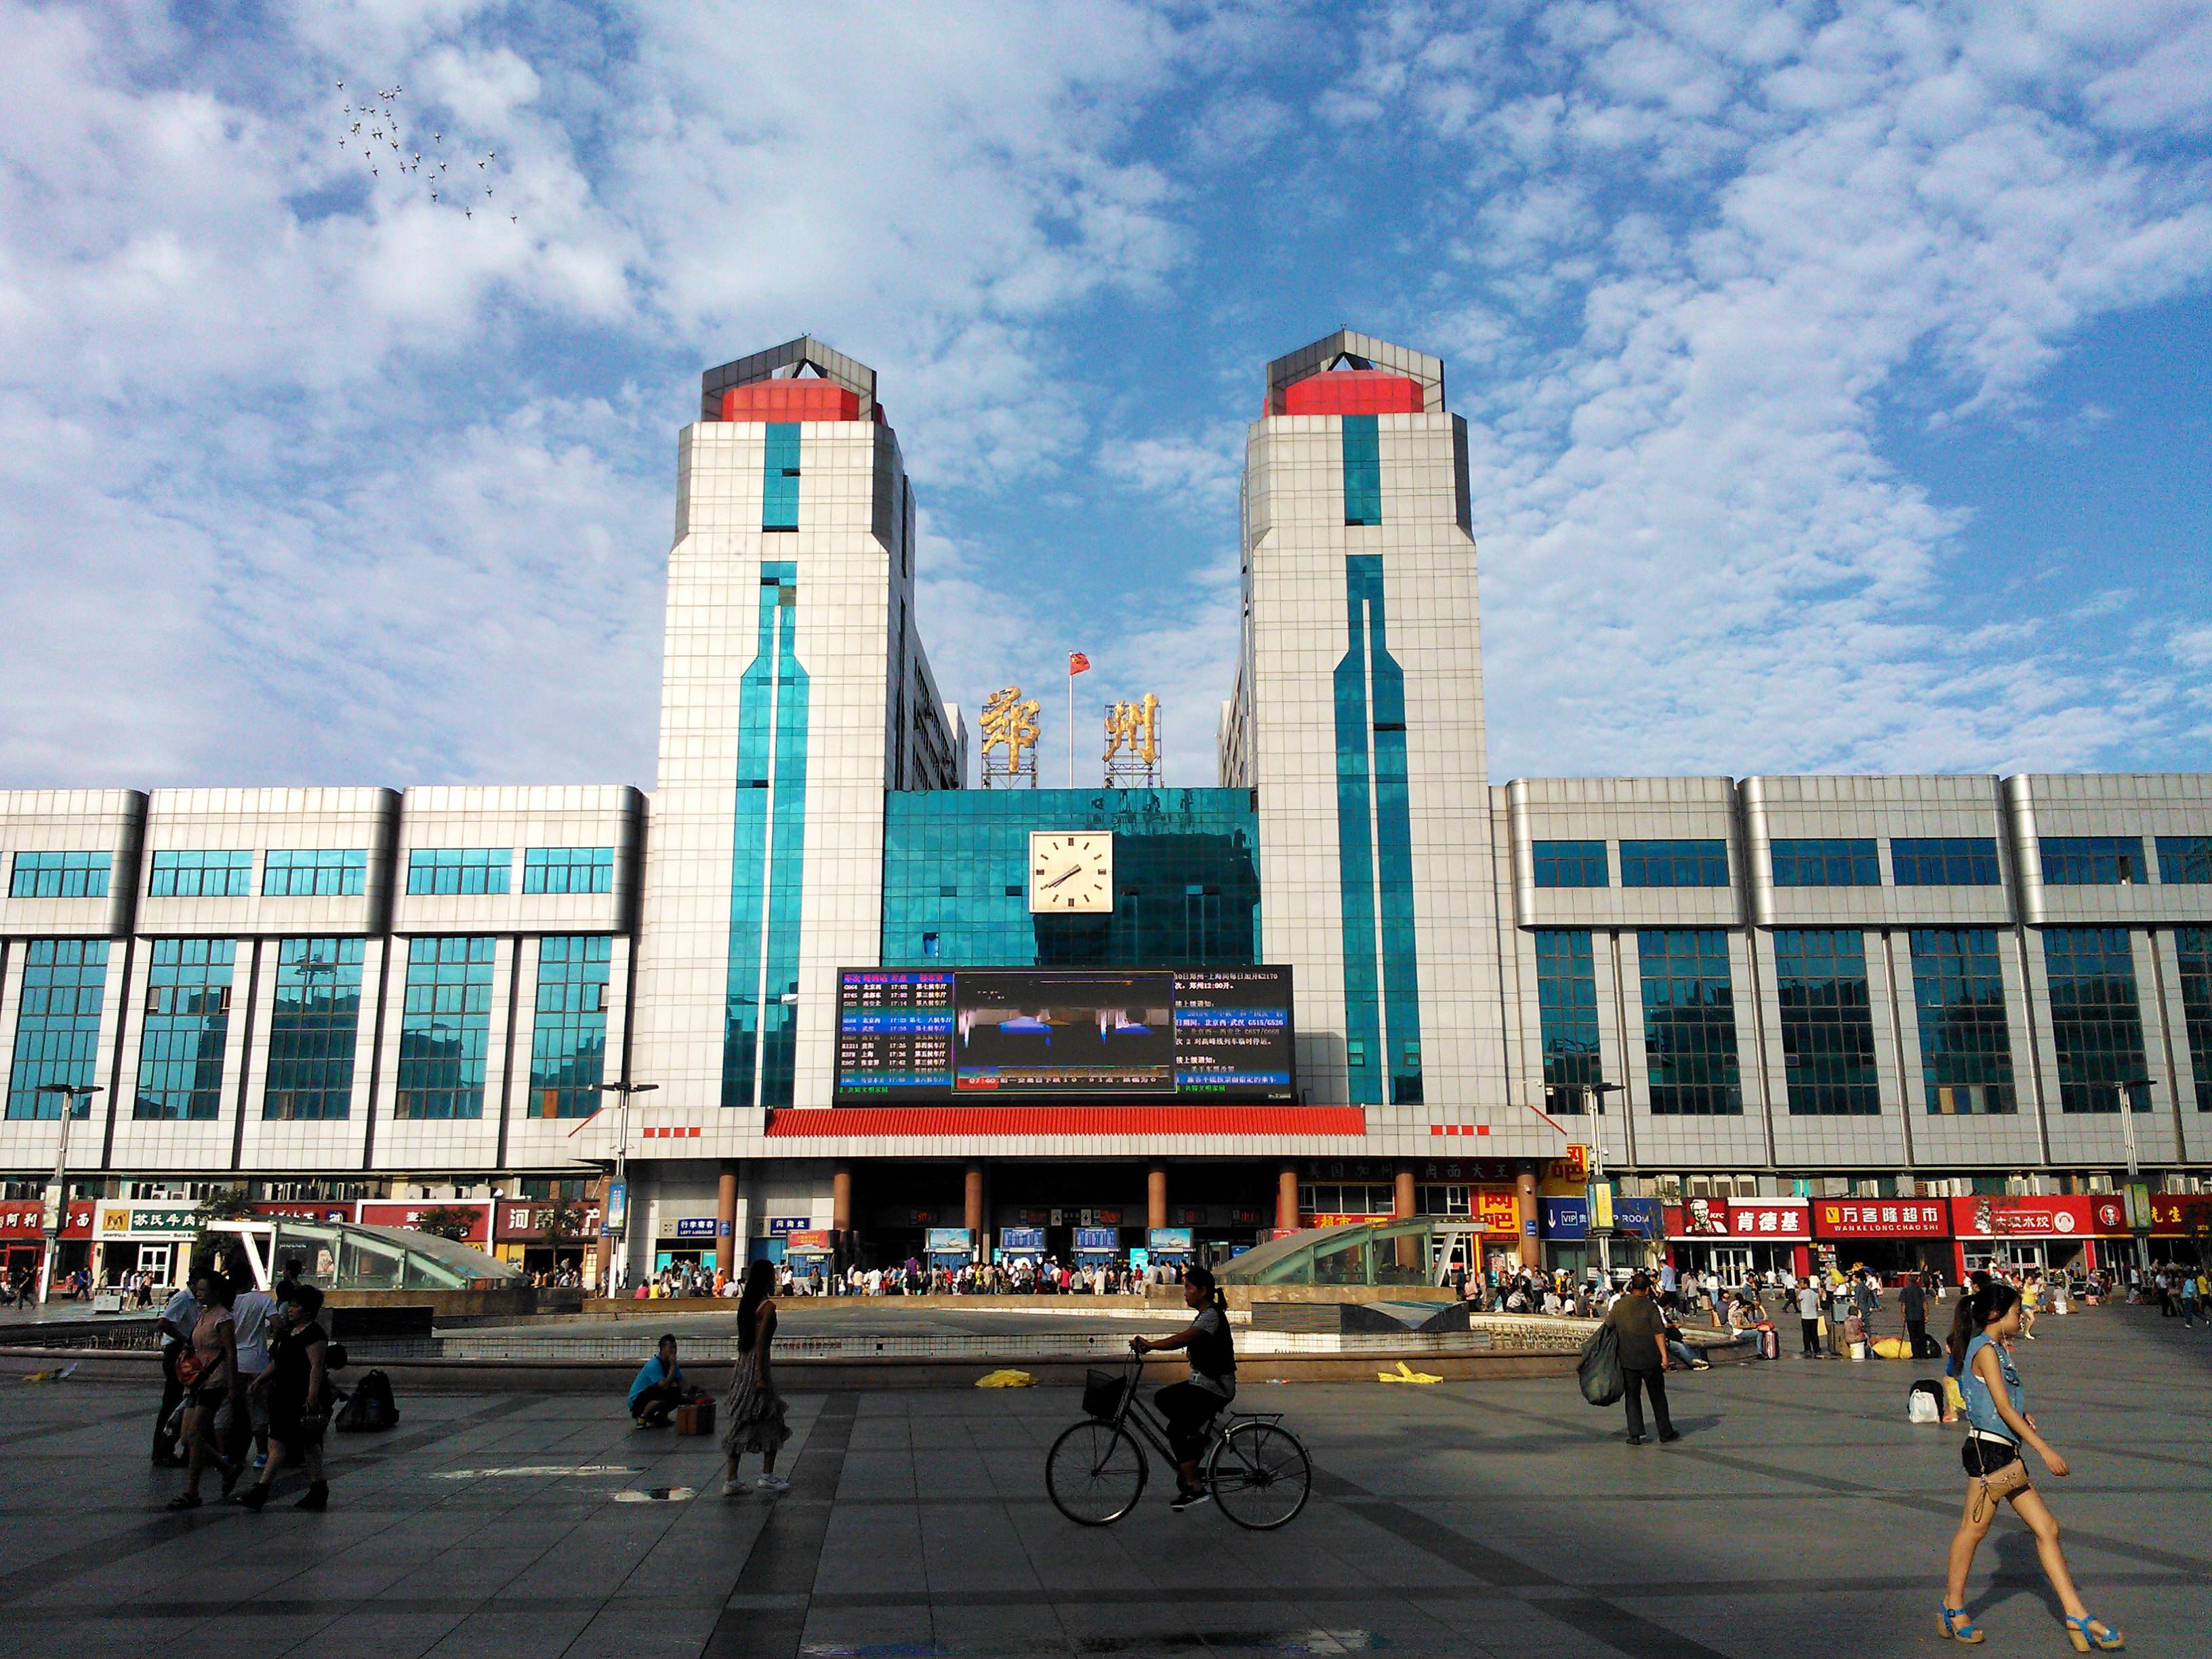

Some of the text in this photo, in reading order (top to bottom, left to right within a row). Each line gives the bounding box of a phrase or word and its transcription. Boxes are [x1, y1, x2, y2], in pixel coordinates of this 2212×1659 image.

[1485, 1192, 1515, 1229] 网吧
[1842, 1207, 1938, 1223] 万客隆超市
[776, 1220, 805, 1228] 问询处
[1562, 1215, 1576, 1223] VIP
[1622, 1214, 1650, 1223] ROOM
[1737, 1211, 1799, 1231] 肯德基
